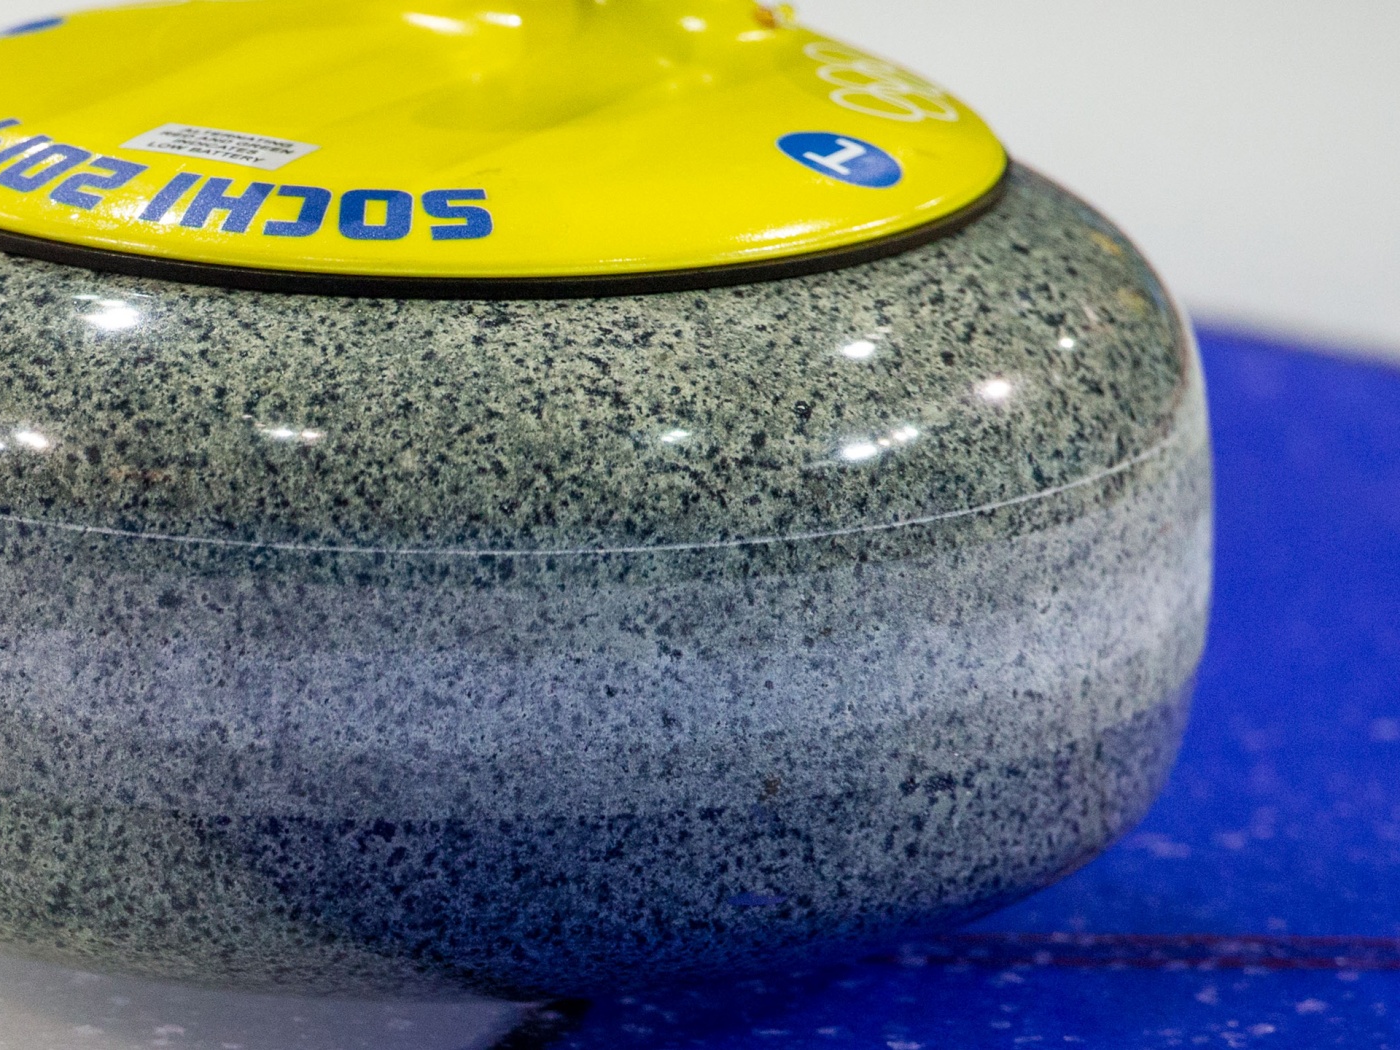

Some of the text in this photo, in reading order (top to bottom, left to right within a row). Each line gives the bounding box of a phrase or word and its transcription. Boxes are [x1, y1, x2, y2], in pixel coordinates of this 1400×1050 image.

[160, 131, 295, 155] RED AND GREEN
[172, 138, 259, 154] INDICATES
[183, 127, 294, 148] ALTERNATING
[147, 141, 266, 163] LOW BATTERY
[138, 173, 492, 240] SOCHI
